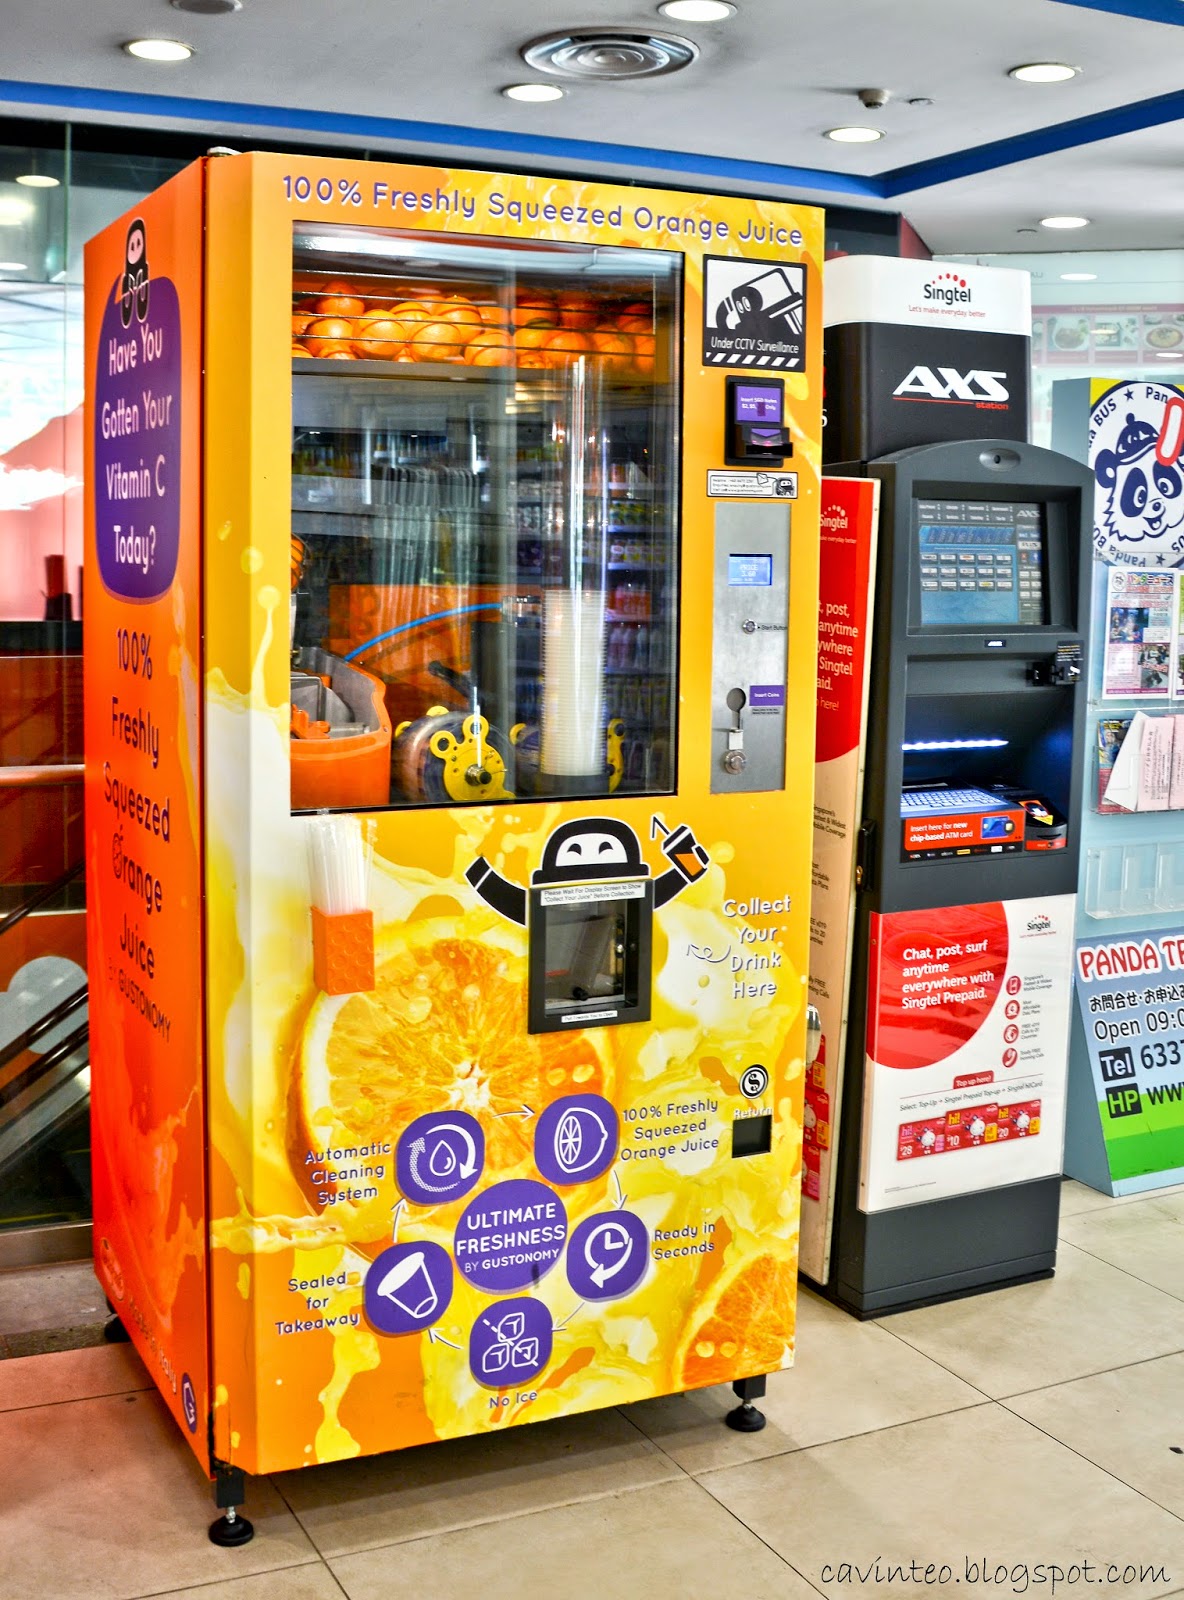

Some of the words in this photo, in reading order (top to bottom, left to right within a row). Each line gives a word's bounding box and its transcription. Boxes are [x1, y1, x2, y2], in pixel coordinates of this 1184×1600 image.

[283, 175, 362, 207] 100%
[373, 182, 476, 219] Freshly
[488, 192, 623, 227] Squeezed
[634, 206, 729, 241] Orange
[738, 219, 803, 246] Juice
[923, 280, 971, 305] Singtel
[109, 338, 137, 376] Have
[141, 323, 163, 363] You
[711, 336, 734, 349] Under
[734, 338, 756, 350] CCTV
[756, 339, 800, 354] Surveillance
[892, 365, 1009, 402] AXS
[1145, 386, 1170, 404] Pan
[102, 398, 139, 440] Gotten
[143, 389, 172, 430] Your
[1093, 398, 1117, 428] BUS
[106, 458, 151, 501] Vitamin
[155, 454, 165, 497] C
[113, 525, 156, 575] Today?
[826, 602, 850, 618] post,
[818, 621, 858, 638] anytime
[117, 628, 153, 680] 100%
[817, 638, 853, 656] ywhere
[819, 656, 853, 676] Singtel
[817, 675, 833, 691] aid.
[112, 695, 159, 769] Freshly
[103, 761, 170, 843] Squeezed
[910, 833, 944, 843] chip-based
[945, 832, 959, 840] ATM
[960, 830, 973, 839] card
[911, 823, 929, 833] Insert
[929, 821, 942, 831] here
[943, 821, 952, 829] for
[953, 821, 968, 830] new
[112, 826, 162, 915] Orange
[723, 894, 791, 917] Collect
[736, 927, 778, 944] Your
[1027, 920, 1051, 931] Singtel
[120, 913, 154, 979] Juice
[903, 948, 933, 960] Chat,
[936, 944, 963, 959] post,
[966, 939, 988, 953] surf
[731, 951, 782, 972] Drink
[902, 962, 949, 978] anytime
[1080, 943, 1159, 978] PANDA
[734, 982, 777, 1000] Here
[902, 976, 967, 993] everywhere
[969, 970, 994, 983] with
[118, 968, 171, 1043] GUSTONOMY
[902, 993, 941, 1010] Singtel
[943, 987, 987, 1004] Prepaid.
[1095, 1020, 1141, 1044] Open
[1101, 1053, 1132, 1077] Tel
[1109, 1090, 1138, 1114] HP
[1146, 1083, 1184, 1105] ww
[623, 1105, 662, 1122] 100%
[667, 1099, 718, 1117] Freshly
[734, 1107, 772, 1120] Return
[634, 1118, 707, 1140] Squeezed
[305, 1141, 391, 1164] Automatic
[620, 1145, 676, 1161] Orange
[681, 1138, 719, 1154] Juice
[310, 1165, 385, 1184] Cleaning
[318, 1187, 378, 1205] System
[467, 1202, 556, 1231] ULTIMATE
[456, 1224, 566, 1256] FRESHNESS
[654, 1224, 698, 1241] Ready
[704, 1221, 715, 1233] in
[464, 1261, 479, 1273] BY
[482, 1248, 560, 1269] GUSTONOMY
[654, 1240, 715, 1260] Seconds
[288, 1271, 347, 1292] Sealed
[306, 1296, 329, 1310] for
[275, 1313, 360, 1336] Takeaway
[489, 1396, 510, 1408] No
[516, 1392, 537, 1403] Ice
